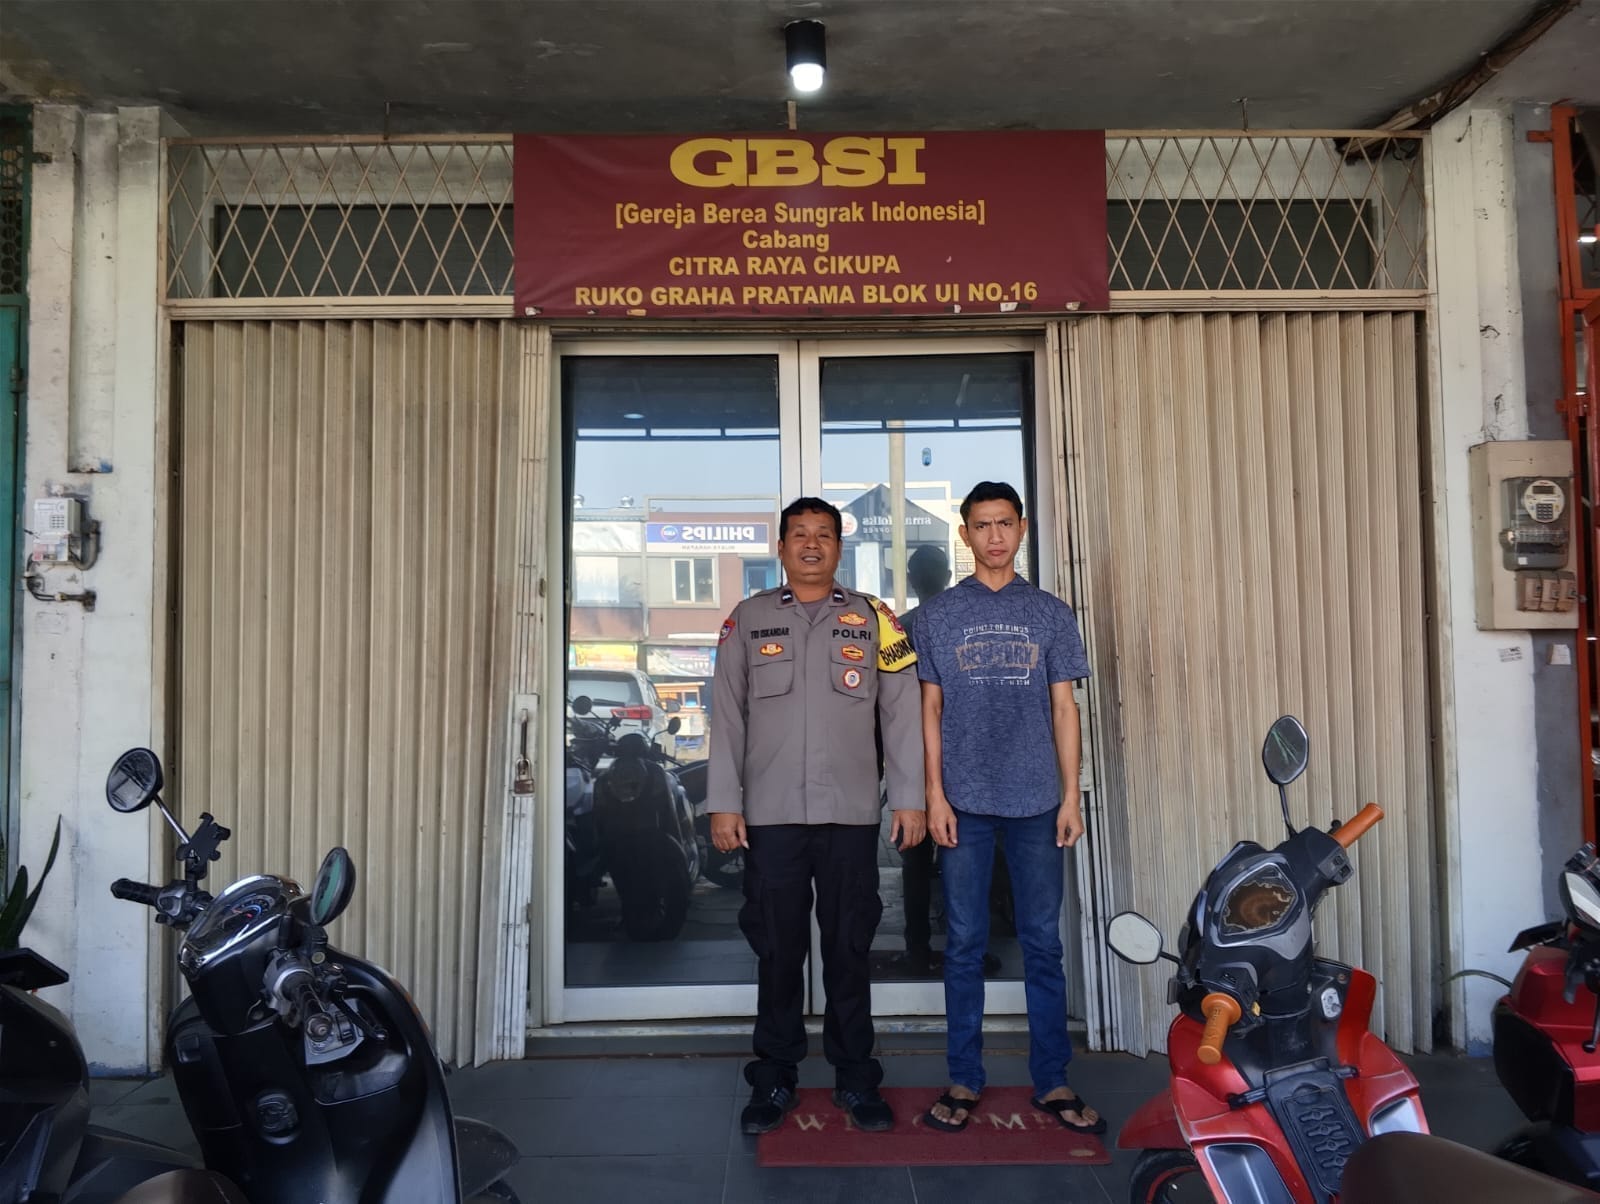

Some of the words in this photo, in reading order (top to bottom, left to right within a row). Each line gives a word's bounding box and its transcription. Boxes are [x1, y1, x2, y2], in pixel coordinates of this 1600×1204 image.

[669, 136, 926, 188] GBSI
[615, 202, 696, 229] [Gereja
[703, 202, 767, 224] Berea
[774, 201, 865, 228] Sungrak
[872, 199, 985, 225] Indonesia]
[742, 229, 830, 252] Cabang
[669, 256, 740, 276] CITRA
[747, 256, 807, 275] RAYA
[813, 255, 901, 275] CIKUPA
[575, 286, 643, 306] RUKO
[650, 286, 735, 306] GRAHA
[742, 285, 855, 305] PRATAMA
[862, 284, 928, 304] BLOK
[968, 281, 1038, 302] NO.16
[832, 628, 872, 641] POLRI
